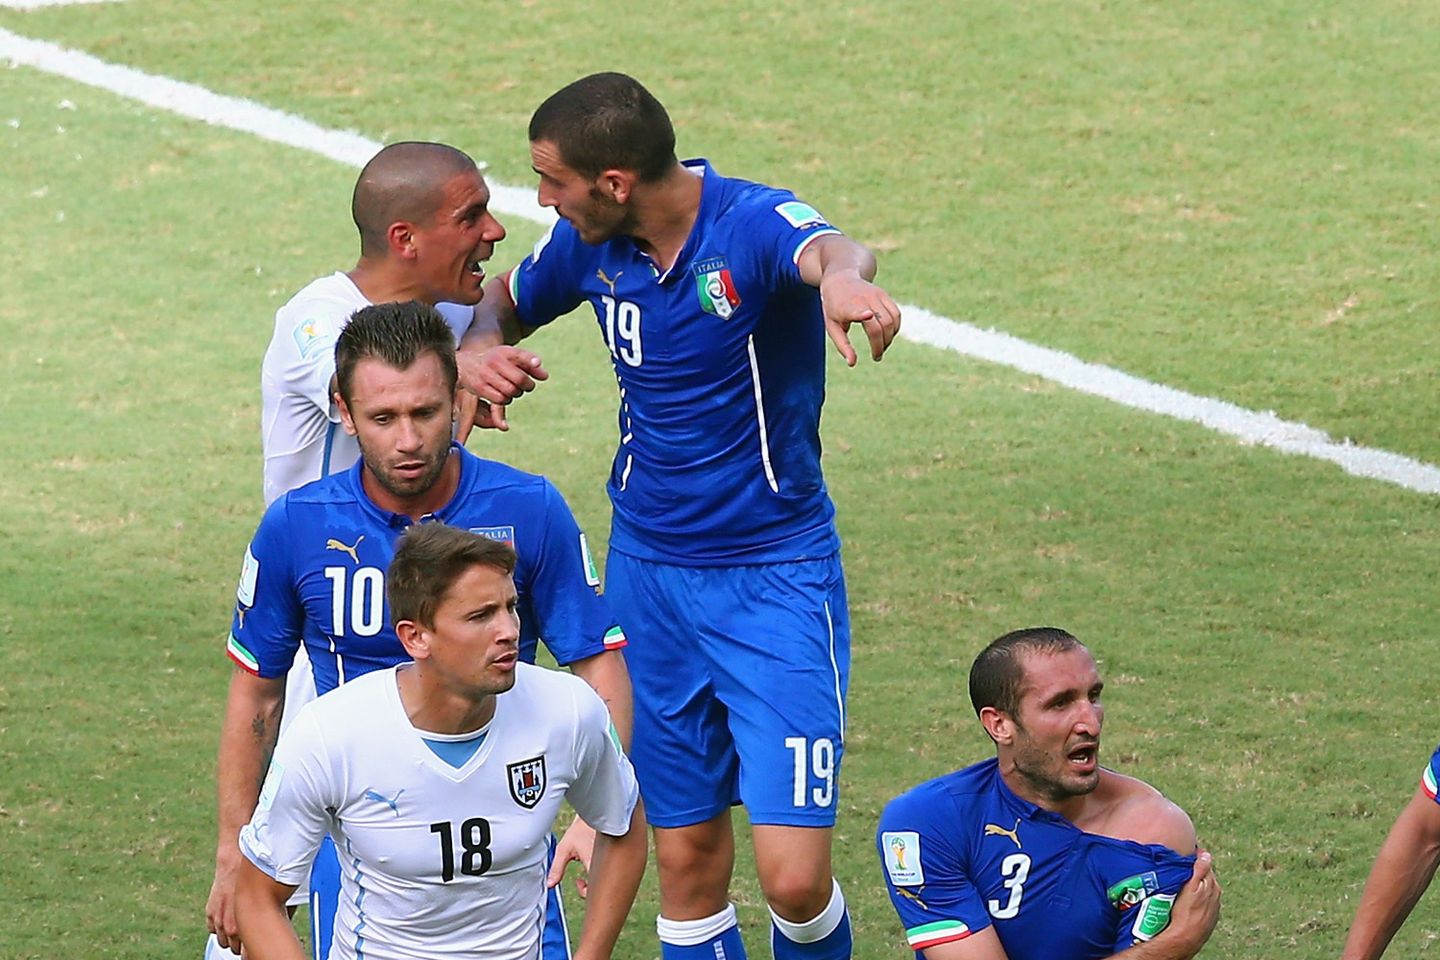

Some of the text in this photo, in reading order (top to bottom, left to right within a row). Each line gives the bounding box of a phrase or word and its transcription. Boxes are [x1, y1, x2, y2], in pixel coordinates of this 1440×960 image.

[697, 261, 726, 273] ITALIA
[601, 295, 643, 367] 19
[324, 566, 385, 637] 10
[784, 736, 834, 807] 19
[430, 817, 492, 882] 18
[988, 853, 1032, 919] 3
